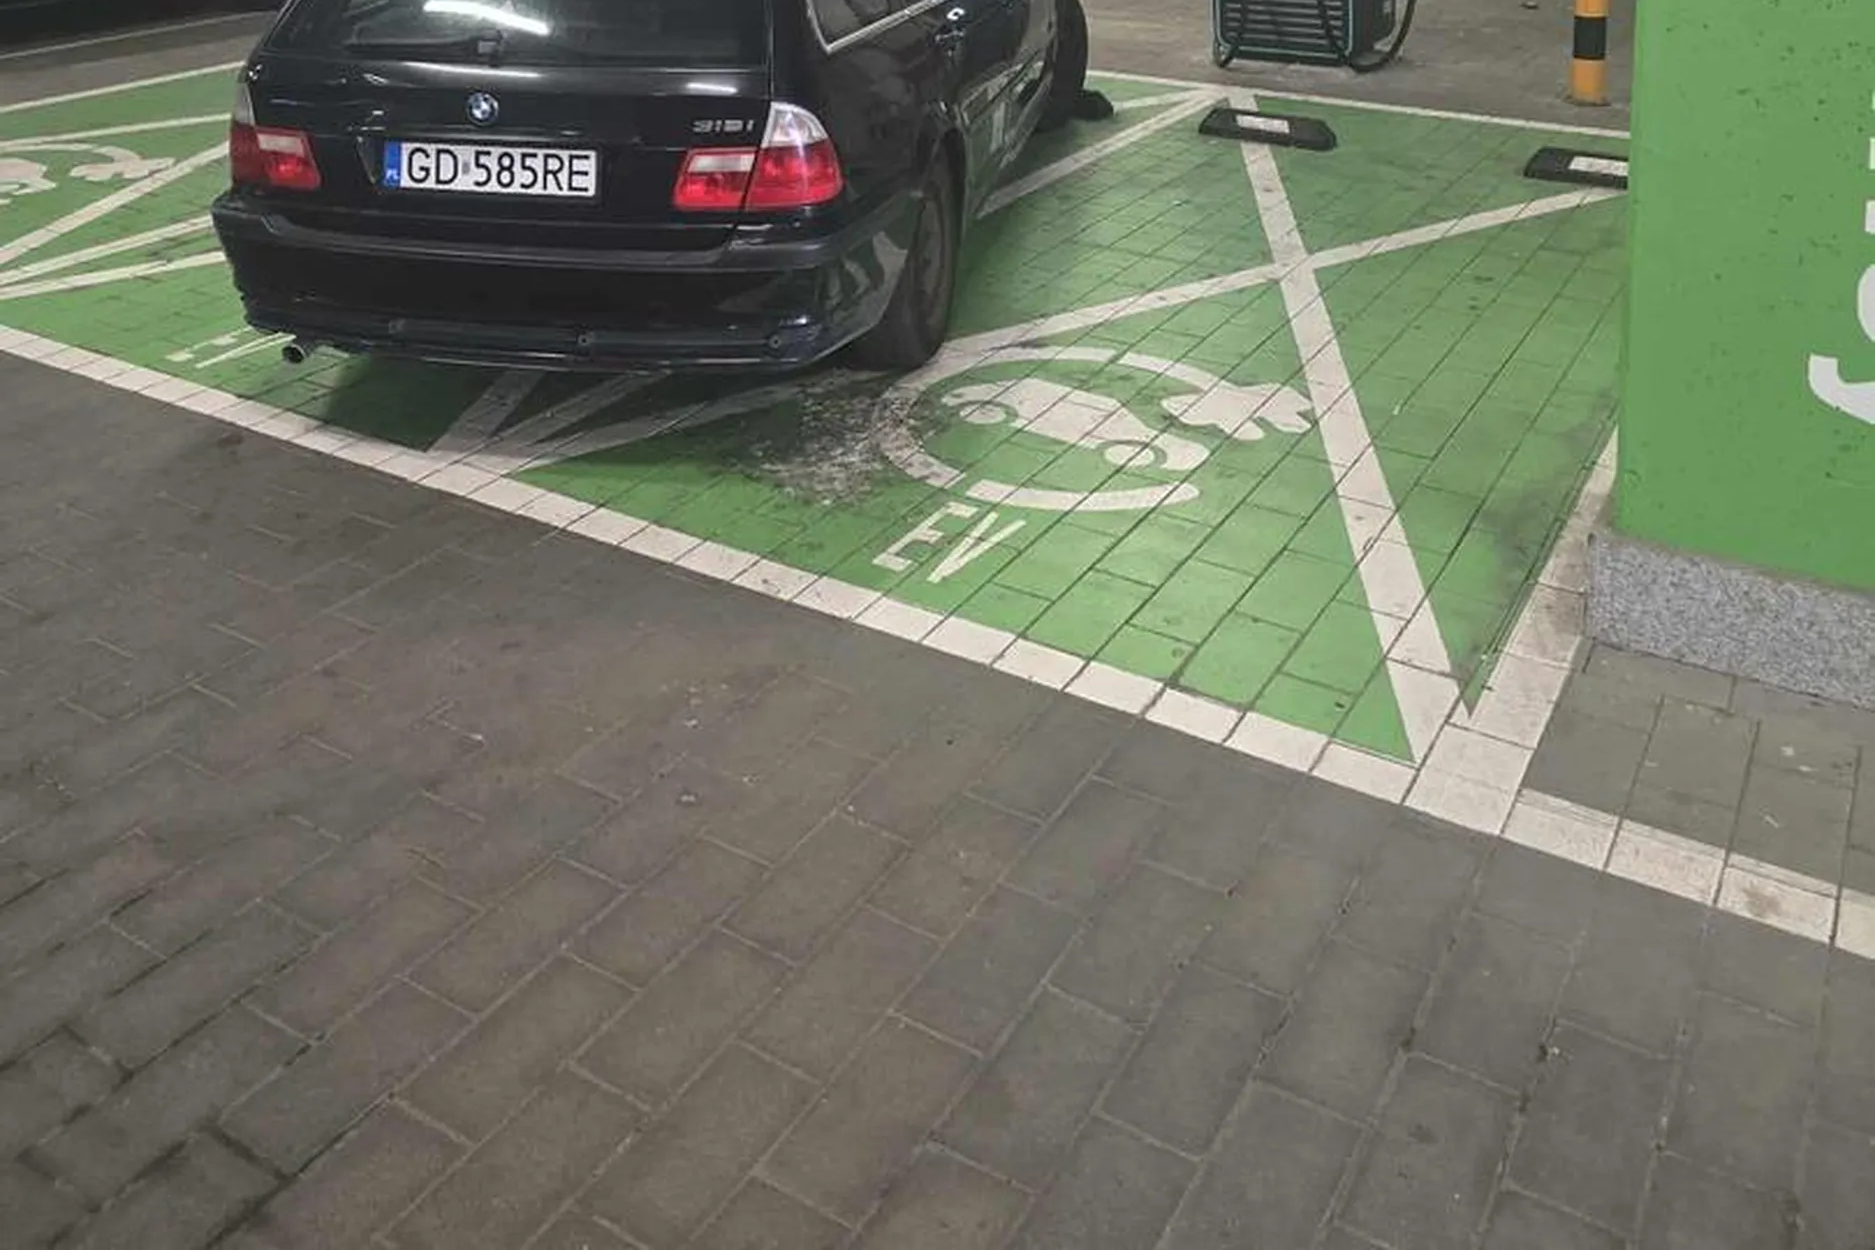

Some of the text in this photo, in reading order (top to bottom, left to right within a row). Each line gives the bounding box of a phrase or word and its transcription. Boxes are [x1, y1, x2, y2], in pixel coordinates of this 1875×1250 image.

[407, 147, 458, 185] GD
[473, 150, 590, 192] 585RE
[872, 502, 1027, 583] EV
